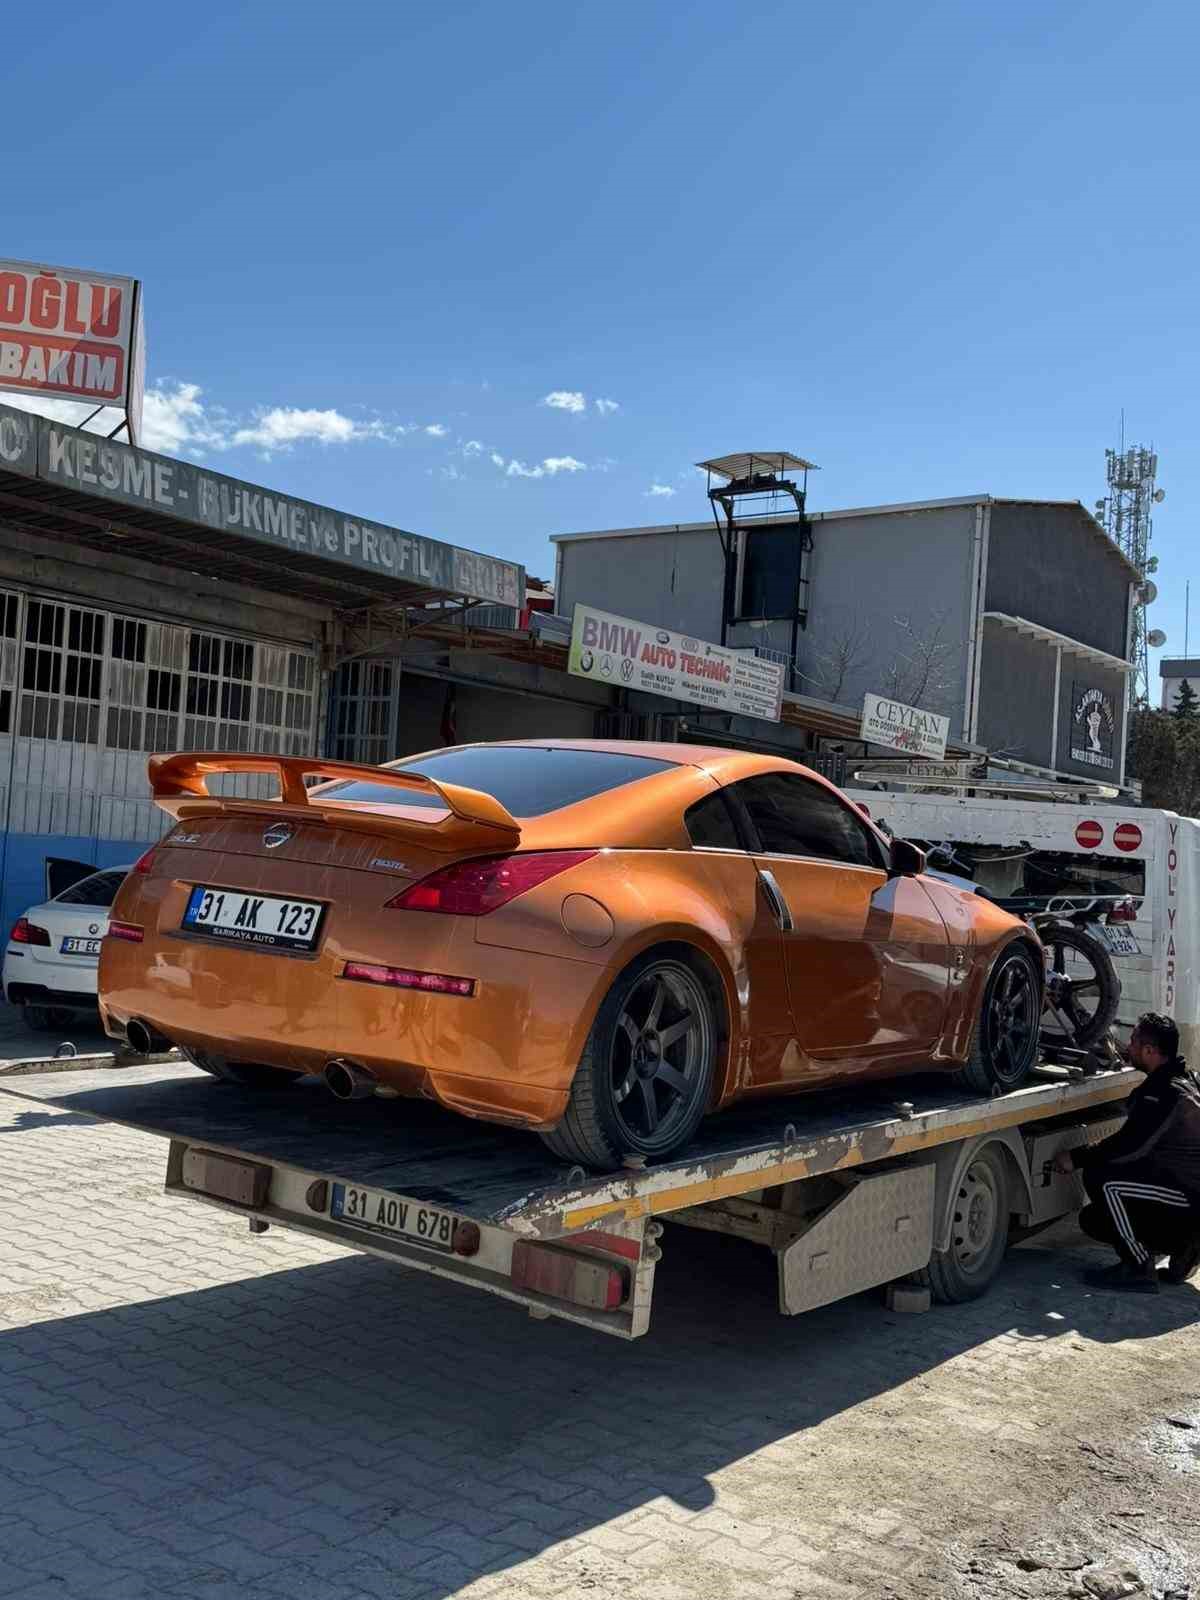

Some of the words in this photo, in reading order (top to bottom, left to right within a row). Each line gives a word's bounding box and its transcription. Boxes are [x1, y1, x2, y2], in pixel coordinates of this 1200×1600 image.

[0, 343, 117, 393] BAKIM
[581, 616, 642, 659] BMW
[640, 643, 677, 670] AUTO
[876, 700, 942, 734] CEYLAN
[1168, 823, 1178, 897] YOL
[199, 893, 225, 922] 31
[234, 898, 264, 928] AK
[277, 904, 316, 935] 123
[69, 940, 80, 950] 31
[252, 934, 275, 944] AUTO
[348, 1189, 367, 1218] 31
[376, 1197, 409, 1229] AOV
[417, 1209, 450, 1241] 678
